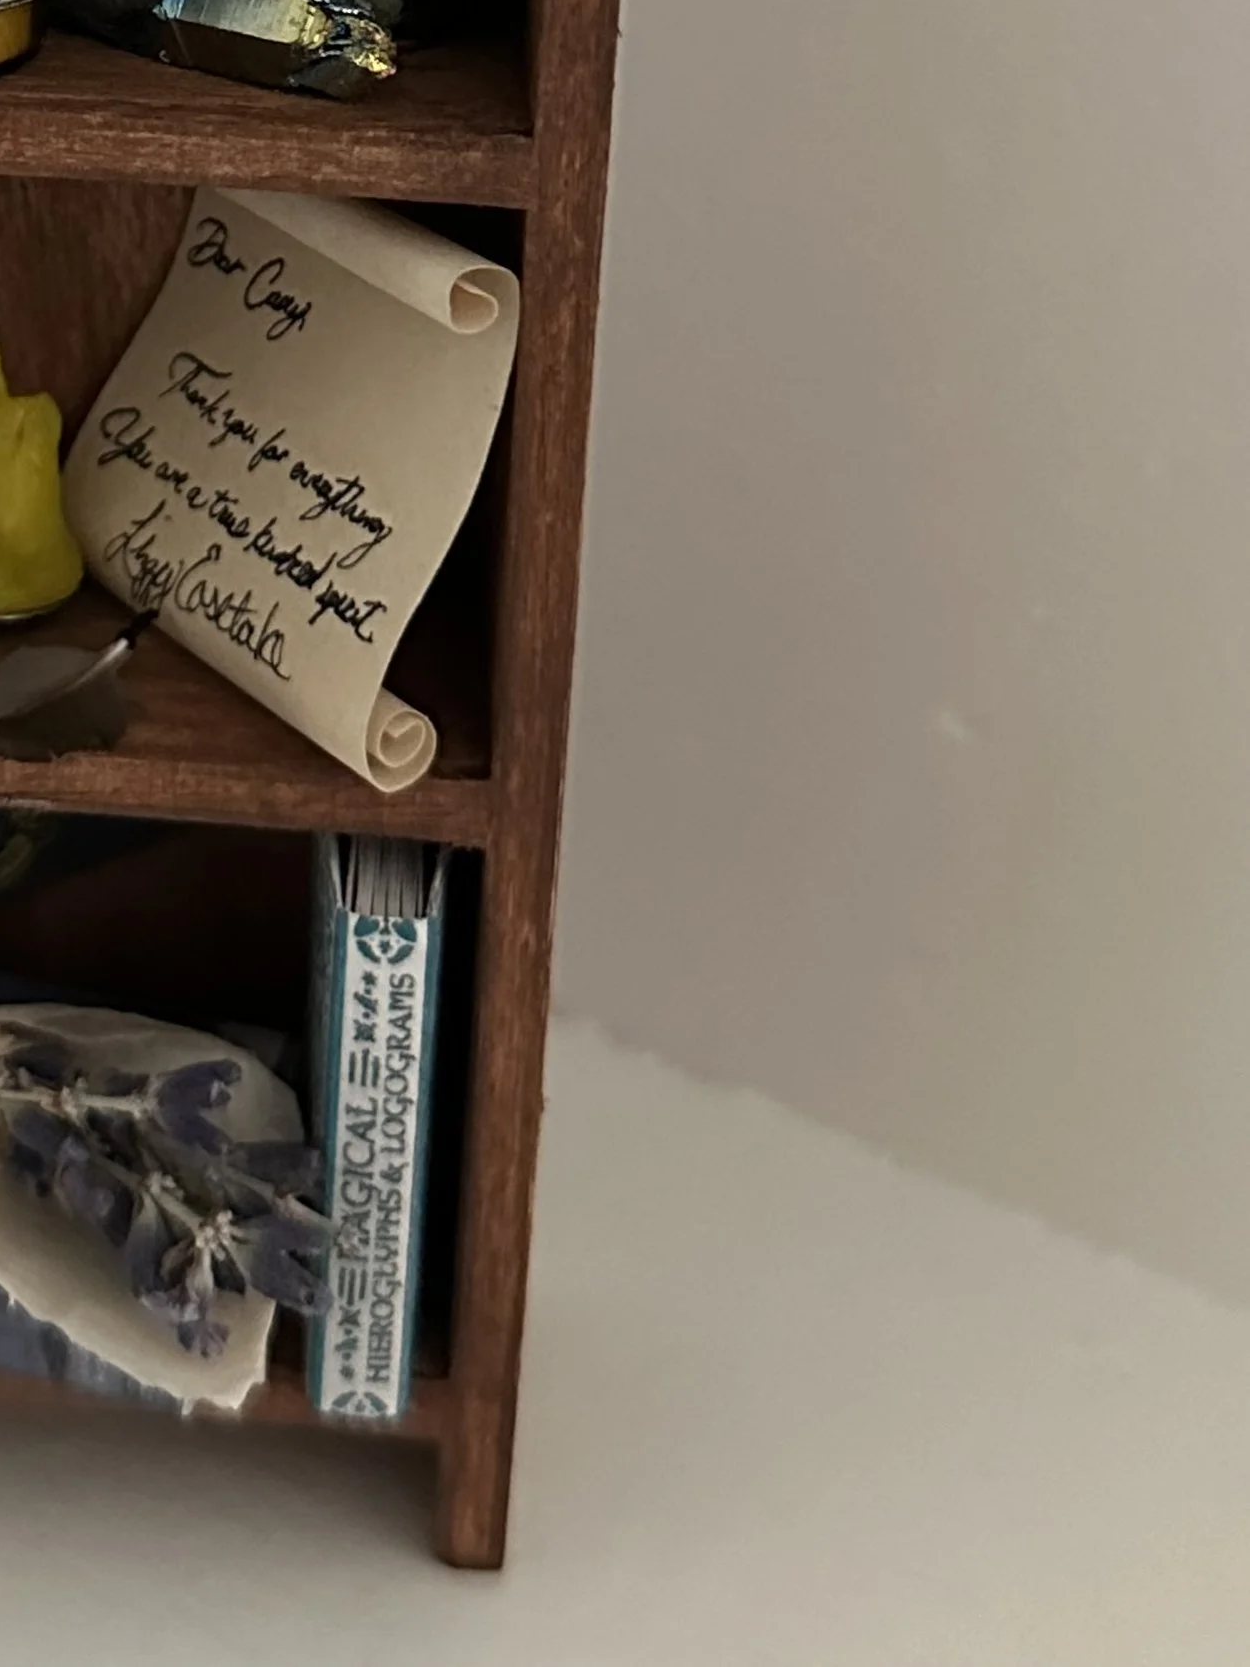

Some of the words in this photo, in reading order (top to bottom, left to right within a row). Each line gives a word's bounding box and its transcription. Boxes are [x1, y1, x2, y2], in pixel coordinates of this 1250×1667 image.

[97, 407, 155, 467] You
[155, 460, 188, 494] are
[186, 487, 208, 510] a
[208, 489, 249, 539] true
[158, 351, 232, 425] Thank
[208, 408, 258, 448] you
[247, 427, 289, 472] for
[289, 461, 393, 569] everything
[380, 972, 416, 1155] LOGOGRAMS
[381, 1161, 409, 1184] &
[365, 1187, 403, 1384] HIEROGLYPHS
